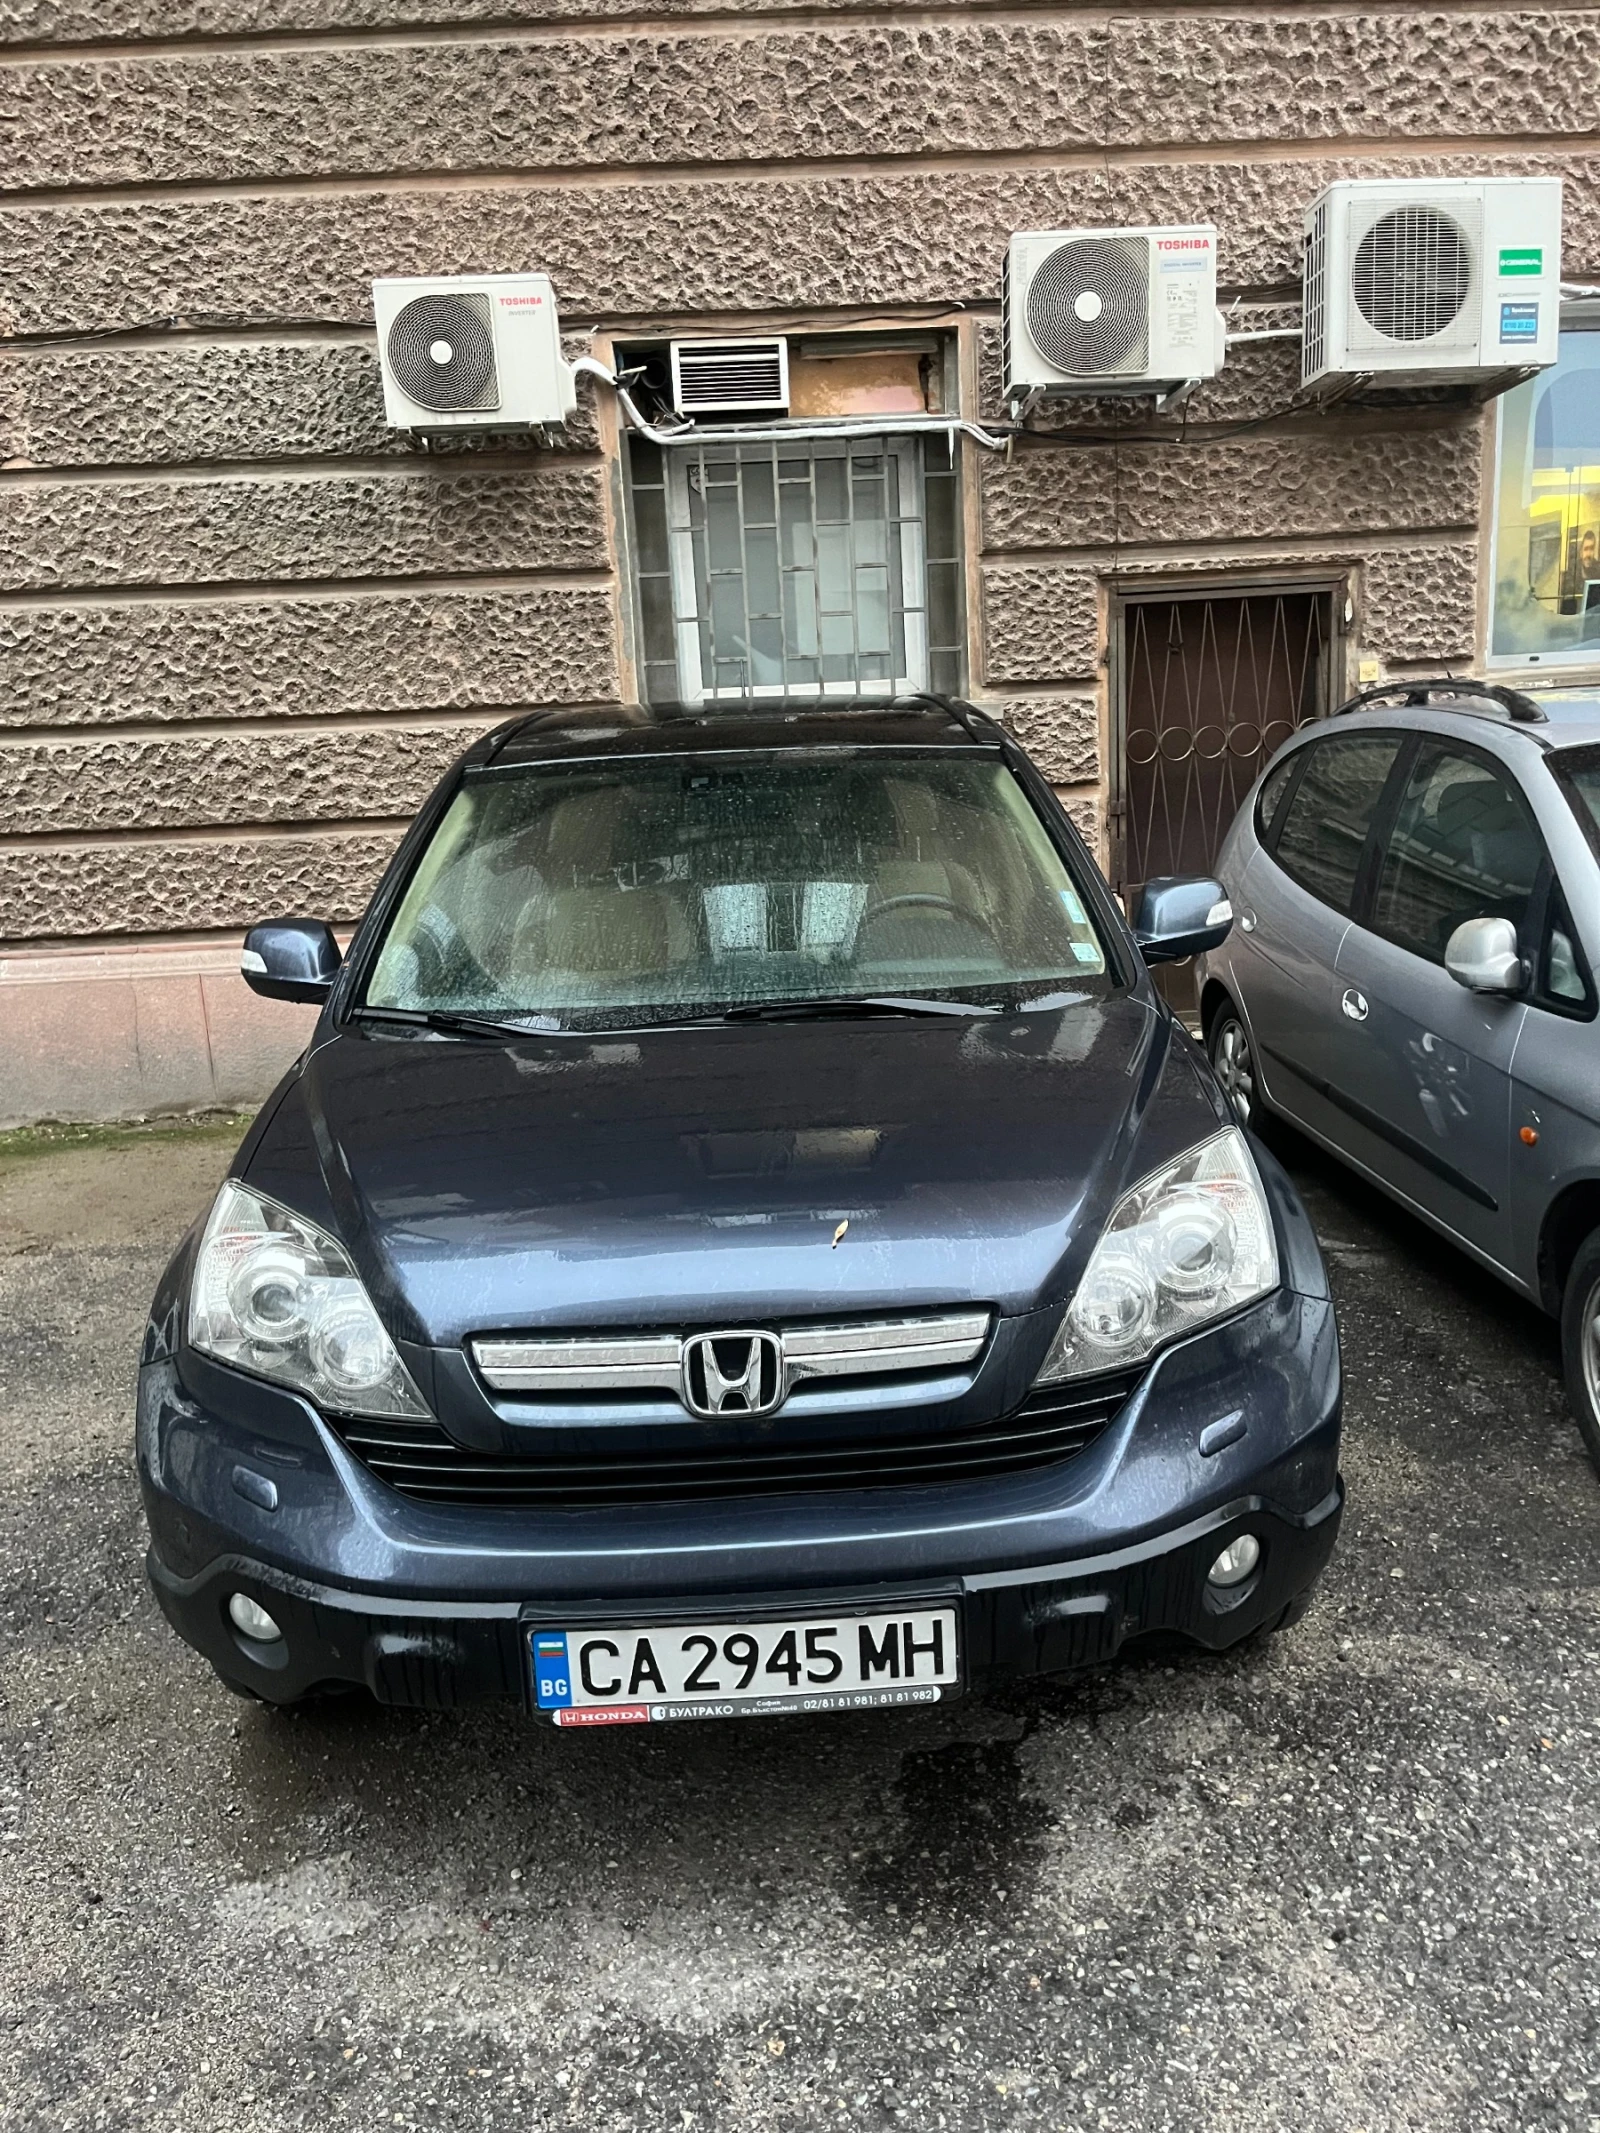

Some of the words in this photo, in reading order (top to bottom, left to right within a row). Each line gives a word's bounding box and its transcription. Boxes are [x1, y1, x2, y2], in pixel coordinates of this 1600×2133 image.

[1156, 239, 1210, 251] TOSHIBA
[499, 297, 543, 306] TOSHIBA
[580, 1637, 667, 1696] CA
[681, 1627, 843, 1692] 2945
[858, 1619, 944, 1681] MH
[541, 1680, 567, 1696] BG
[803, 1697, 835, 1710] 02/81
[838, 1695, 850, 1707] 81
[854, 1693, 877, 1706] 981;
[880, 1692, 892, 1704] 81
[896, 1691, 908, 1703] 81
[912, 1689, 932, 1701] 982
[581, 1710, 647, 1721] HONDA
[669, 1705, 734, 1718] БУЛТРАКО
